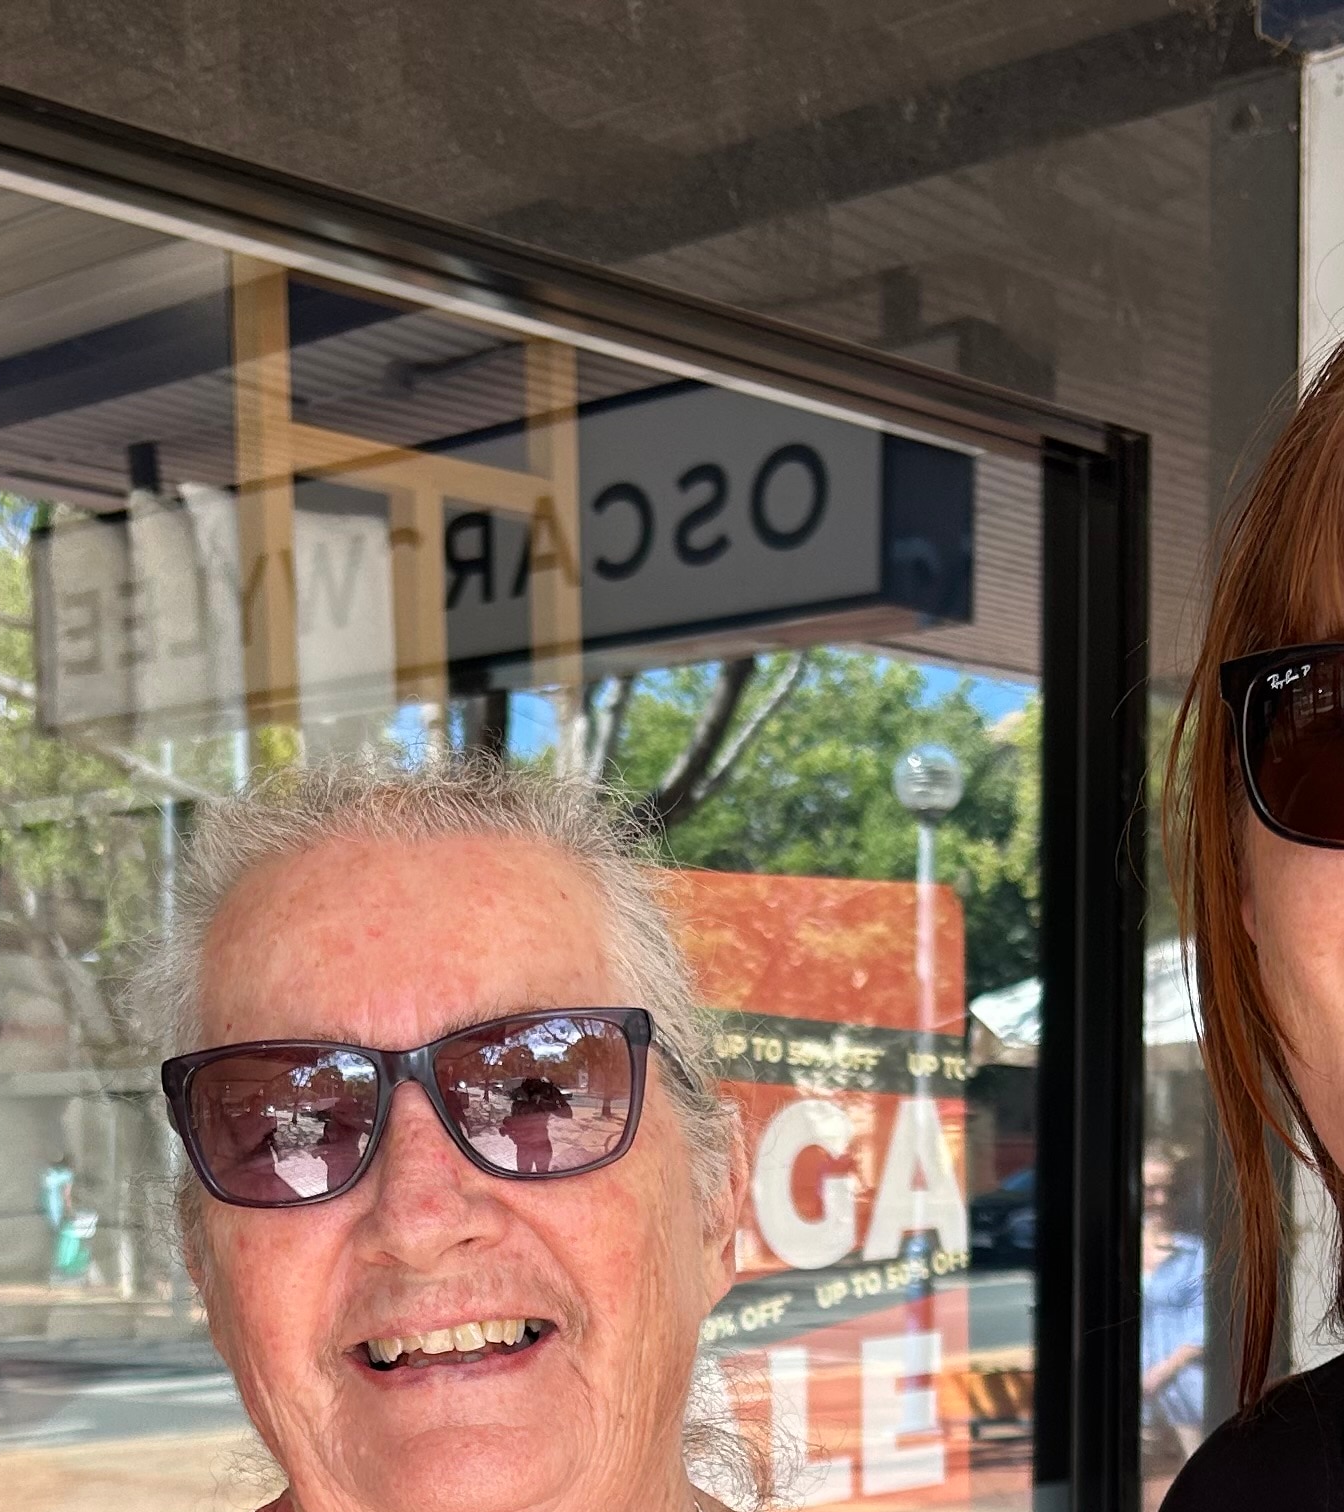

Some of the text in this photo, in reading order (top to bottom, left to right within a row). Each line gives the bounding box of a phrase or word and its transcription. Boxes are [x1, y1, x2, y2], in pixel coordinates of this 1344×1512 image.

[751, 1036, 783, 1064] TO
[735, 1096, 970, 1271] GA
[700, 1314, 737, 1341] 0%
[815, 1280, 849, 1309] UP
[851, 1269, 883, 1299] TO
[706, 1332, 946, 1502] LE
